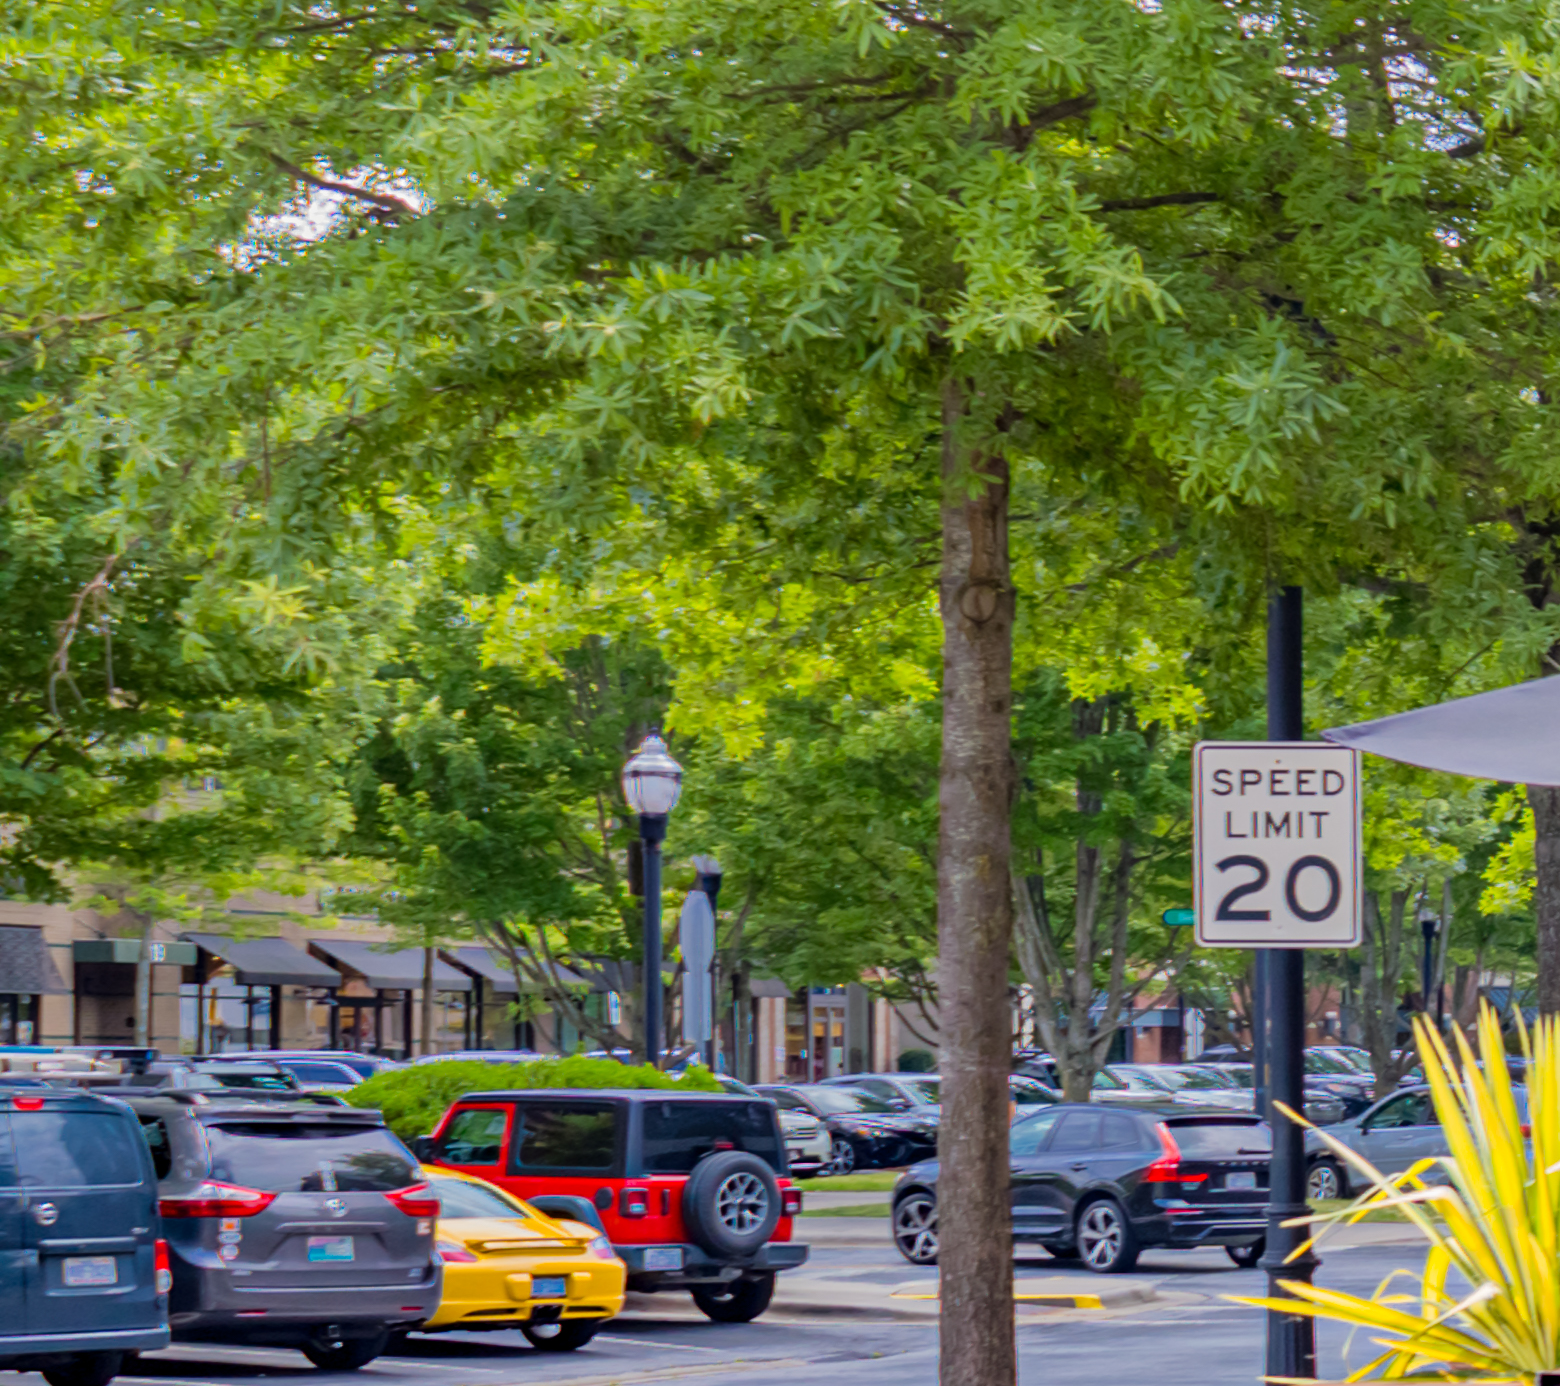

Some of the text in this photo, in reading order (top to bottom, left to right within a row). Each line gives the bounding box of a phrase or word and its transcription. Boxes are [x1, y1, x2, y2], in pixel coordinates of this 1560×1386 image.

[1211, 769, 1345, 796] SPEED
[1225, 811, 1330, 838] LIMIT
[1214, 855, 1342, 922] 20
